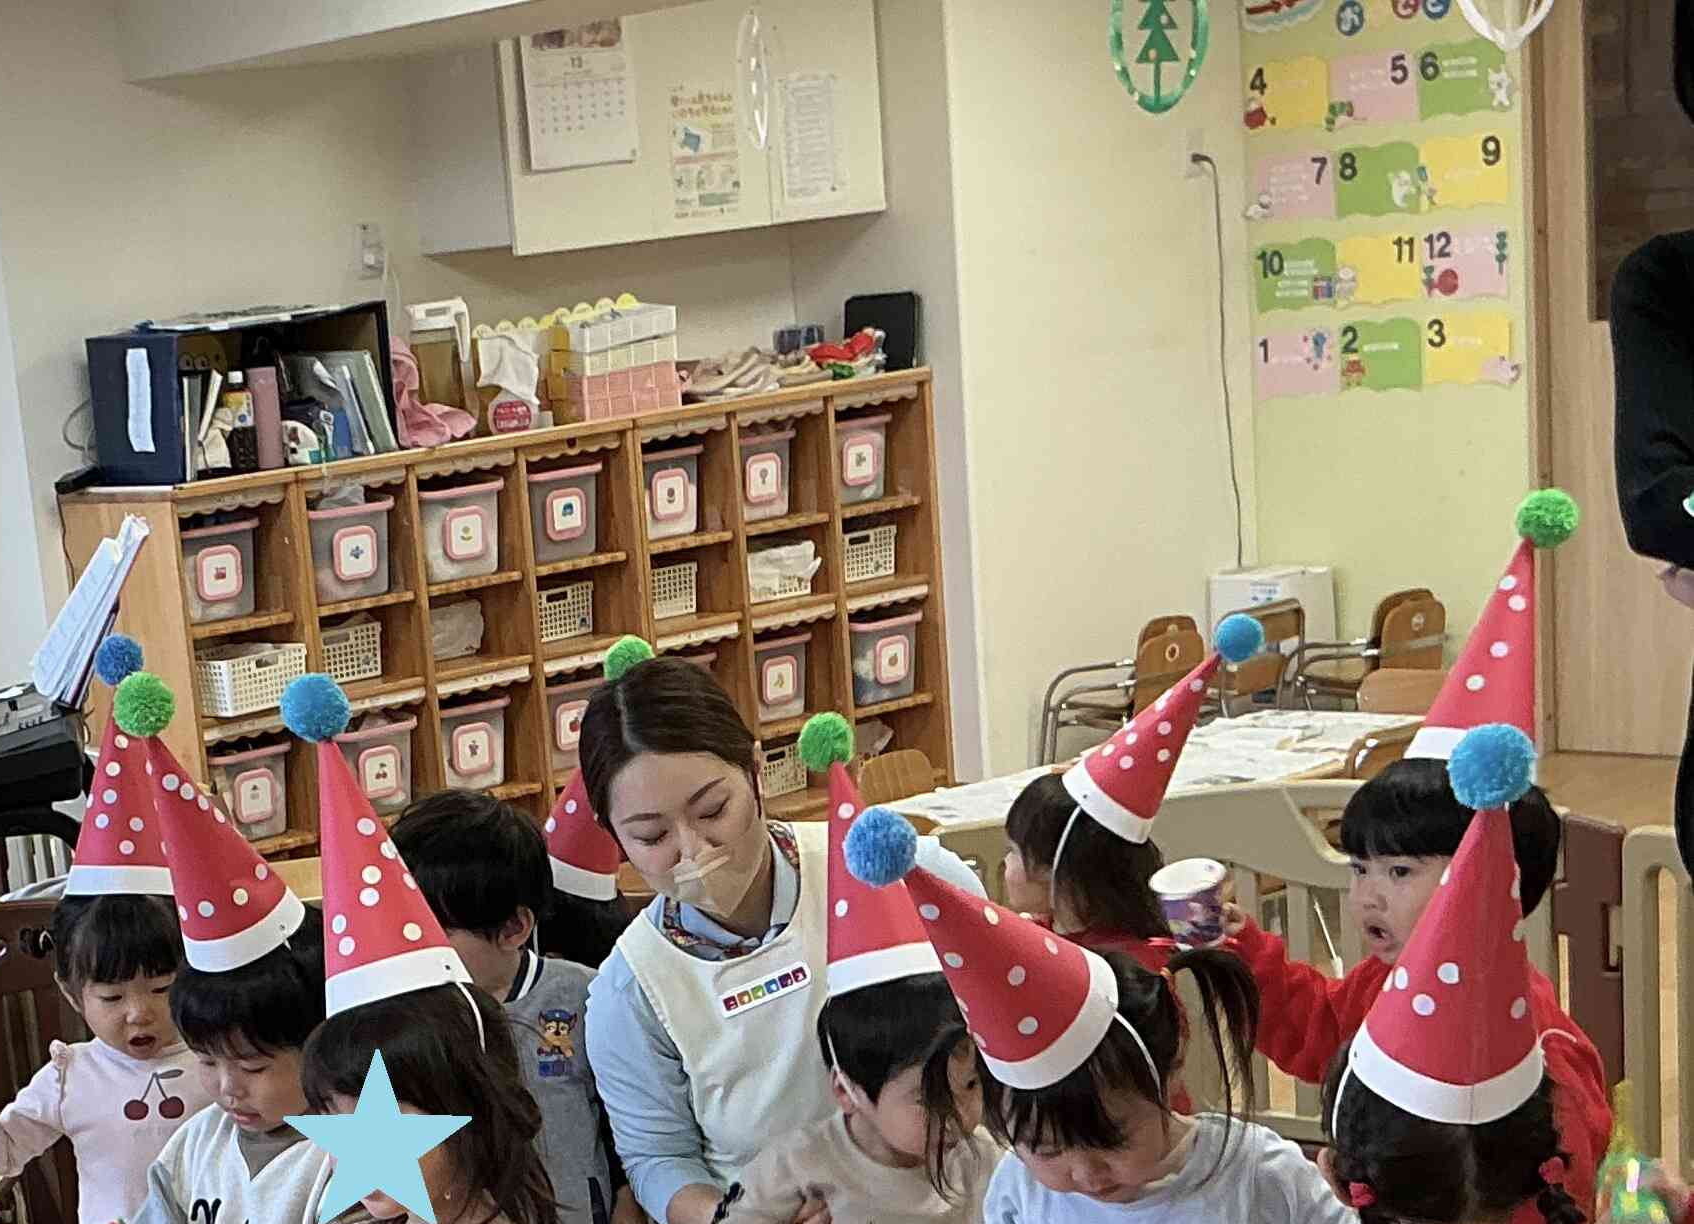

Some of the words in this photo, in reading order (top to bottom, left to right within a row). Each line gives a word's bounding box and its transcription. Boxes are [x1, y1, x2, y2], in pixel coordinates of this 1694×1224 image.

[1390, 54, 1409, 84] 5
[1419, 52, 1440, 81] 6
[1250, 68, 1267, 95] 4
[1481, 136, 1501, 166] 9
[1311, 157, 1328, 185] 7
[1339, 152, 1358, 181] 8
[1393, 236, 1415, 263] 11
[1424, 231, 1452, 260] 12
[1257, 250, 1284, 278] 10
[1342, 325, 1358, 353] 2
[1427, 319, 1446, 348] 3
[1259, 339, 1269, 363] 1
